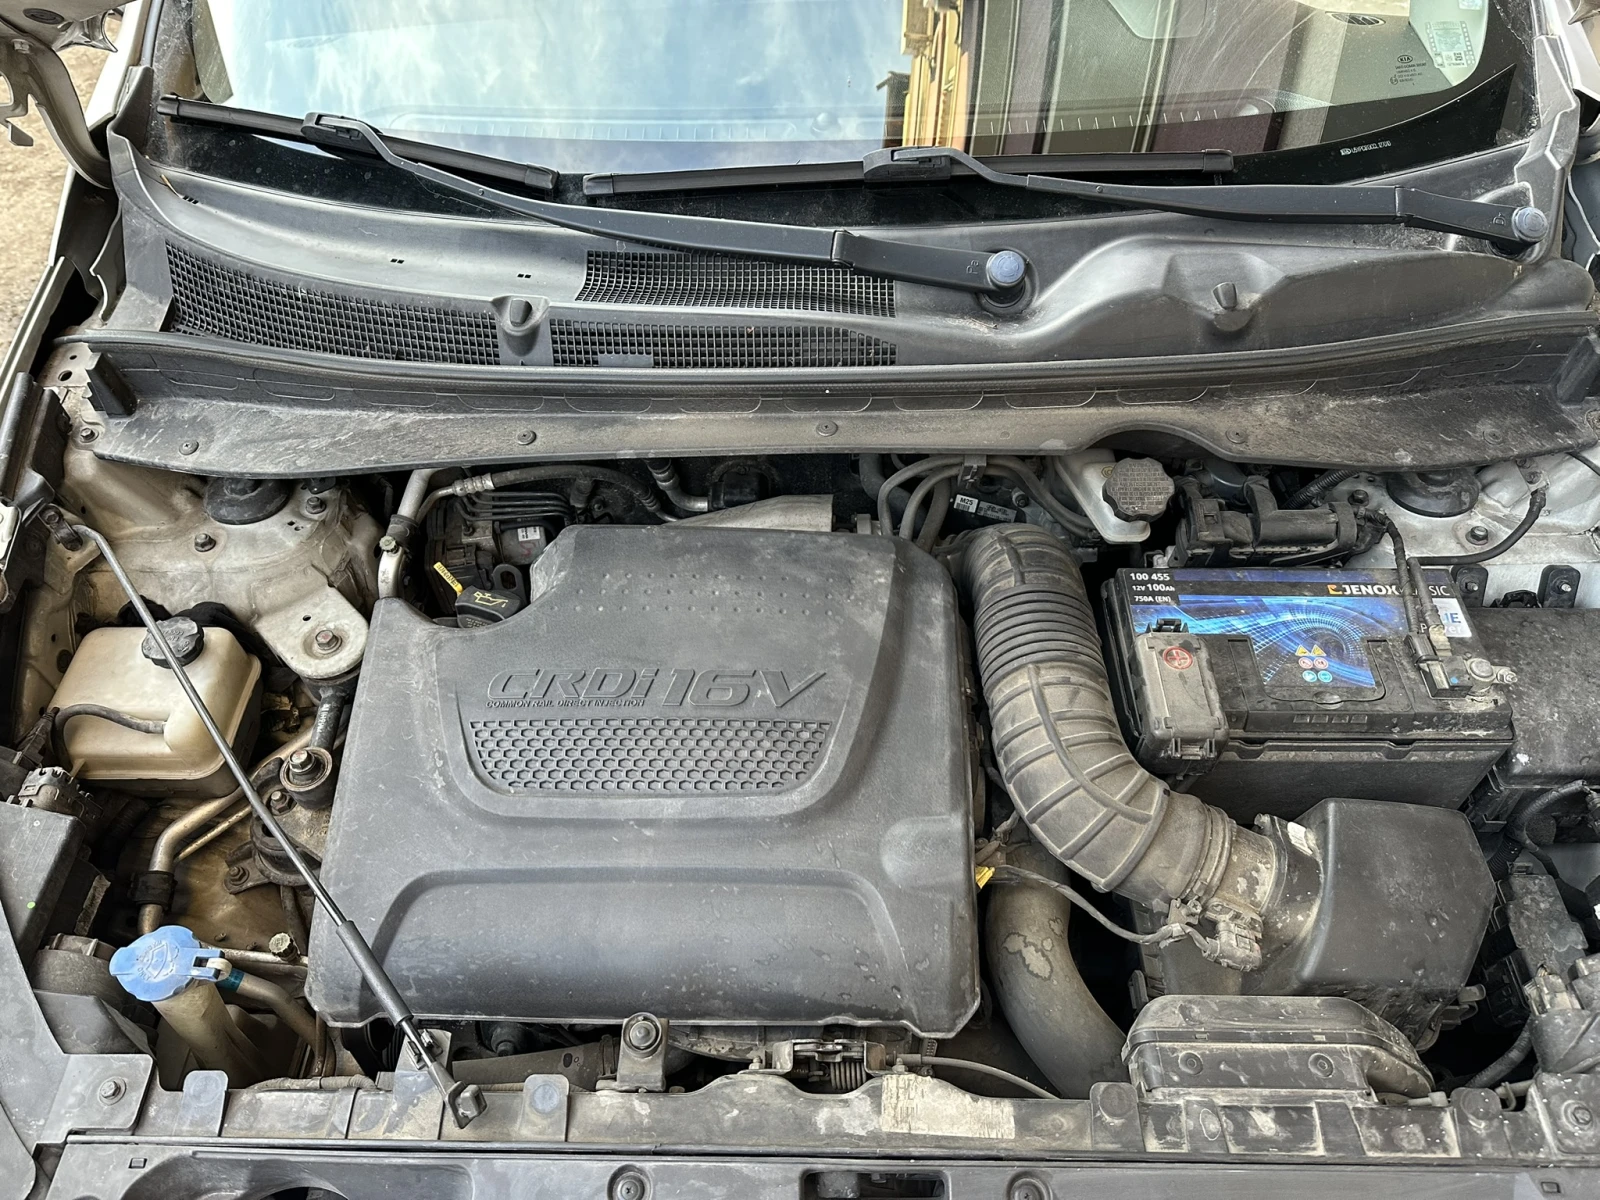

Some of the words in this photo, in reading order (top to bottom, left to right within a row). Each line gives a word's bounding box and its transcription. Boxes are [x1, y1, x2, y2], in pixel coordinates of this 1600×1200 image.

[959, 497, 974, 506] M25
[1129, 572, 1149, 581] 100
[1150, 573, 1171, 581] 455
[1146, 583, 1176, 592] 100Ah
[1341, 584, 1401, 596] JENOX
[487, 667, 660, 700] CRDi
[661, 667, 827, 708] 16V
[485, 699, 531, 708] COMMON
[531, 699, 555, 708] RAIL
[556, 699, 594, 708] DIRECT
[594, 699, 646, 707] INJECTION
